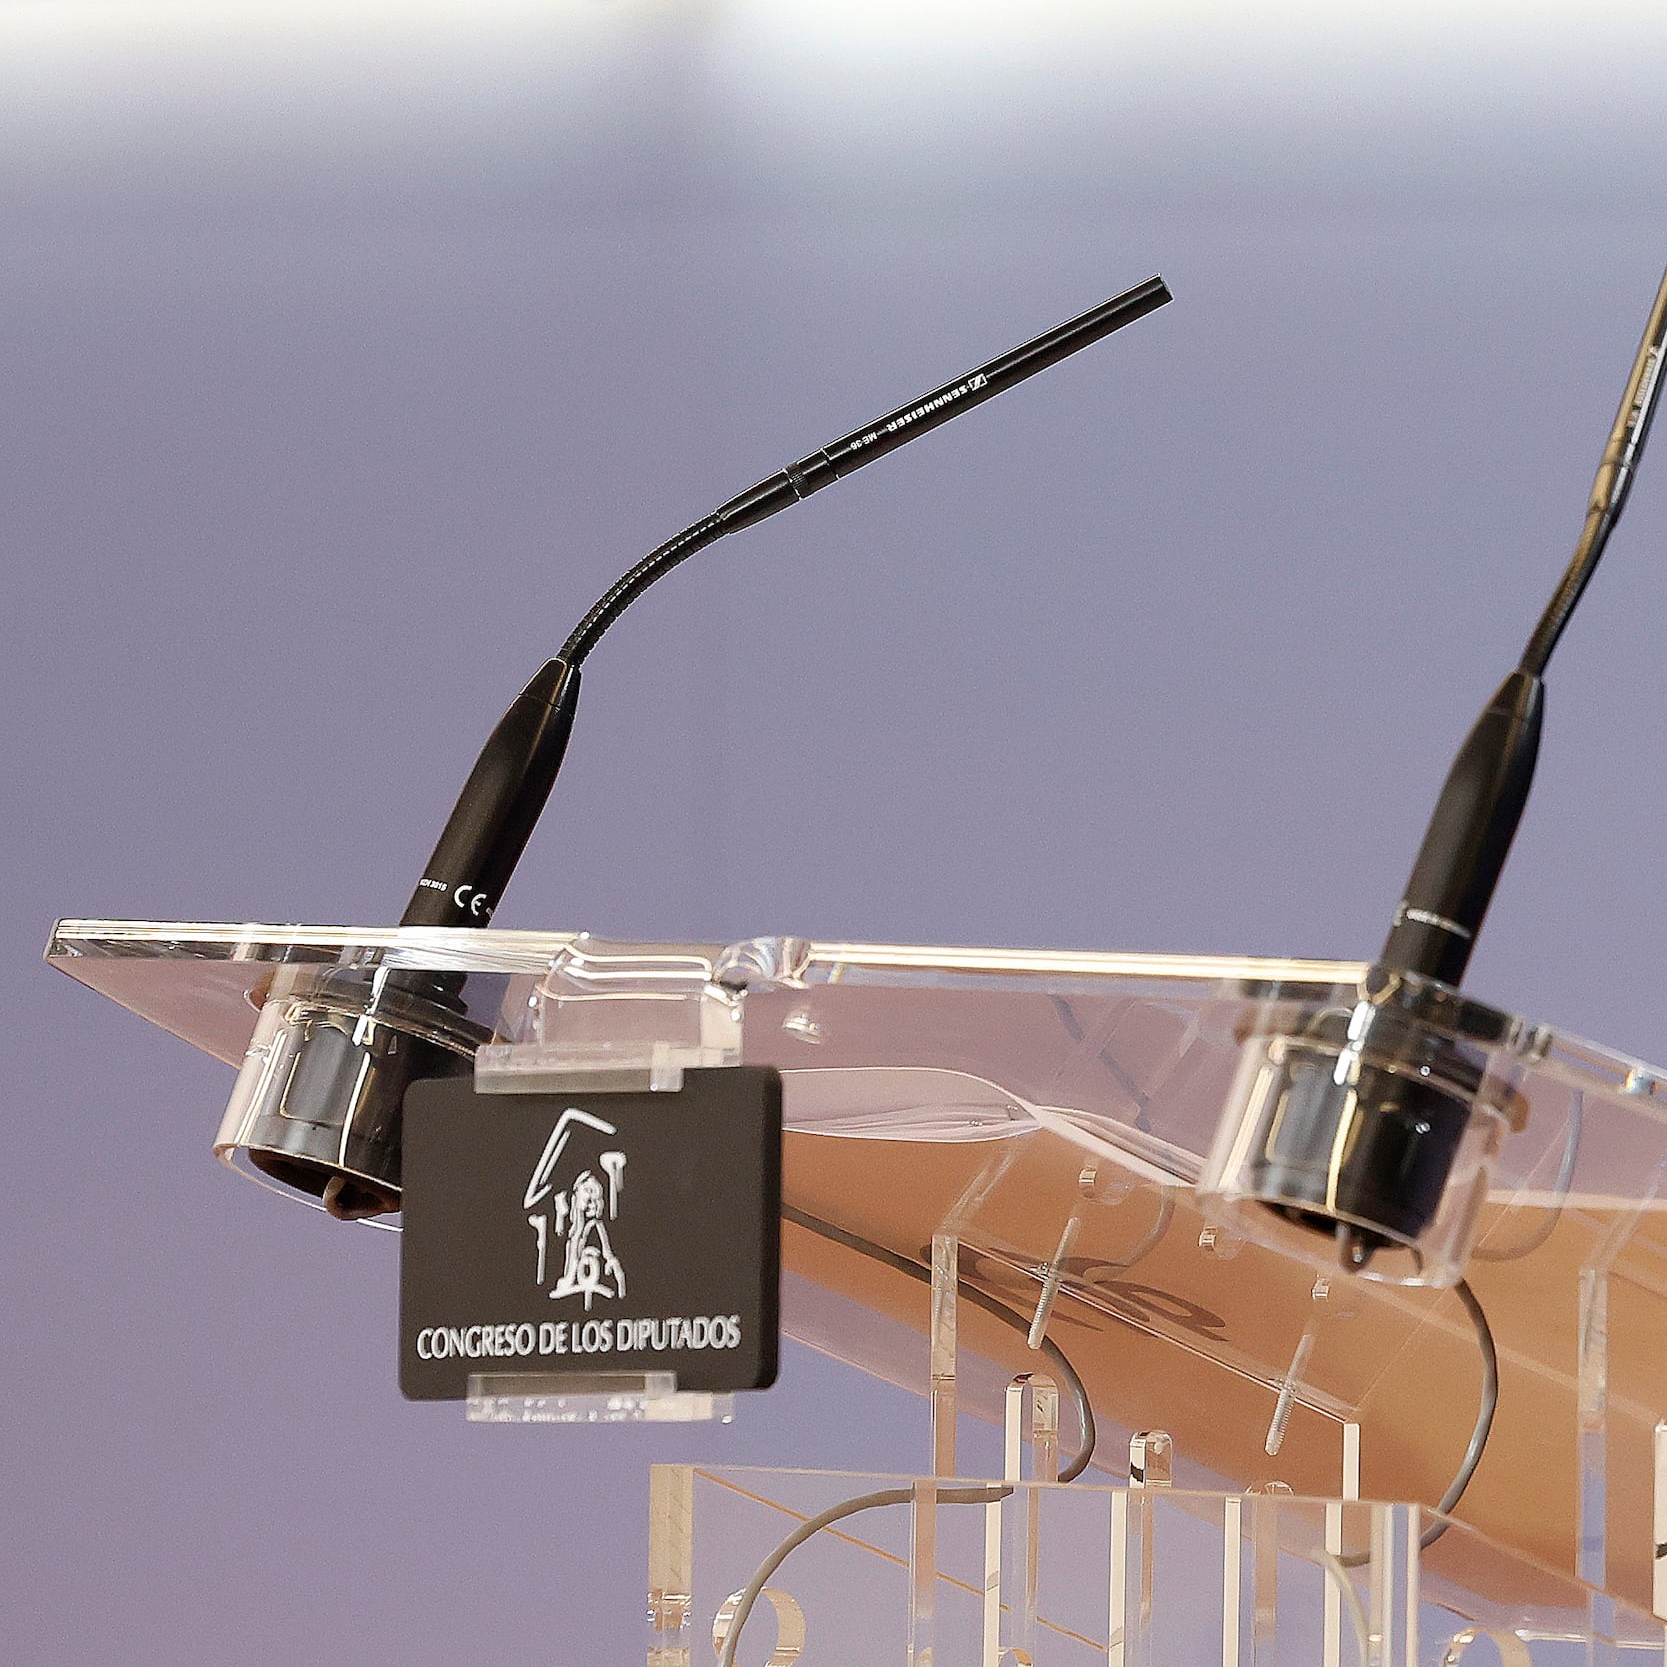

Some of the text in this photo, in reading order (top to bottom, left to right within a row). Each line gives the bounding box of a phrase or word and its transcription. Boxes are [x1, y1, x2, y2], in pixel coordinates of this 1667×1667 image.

[886, 385, 968, 432] SENNHEISER
[417, 1314, 742, 1360] CONGRESO DE LOS DIPUTADOS
